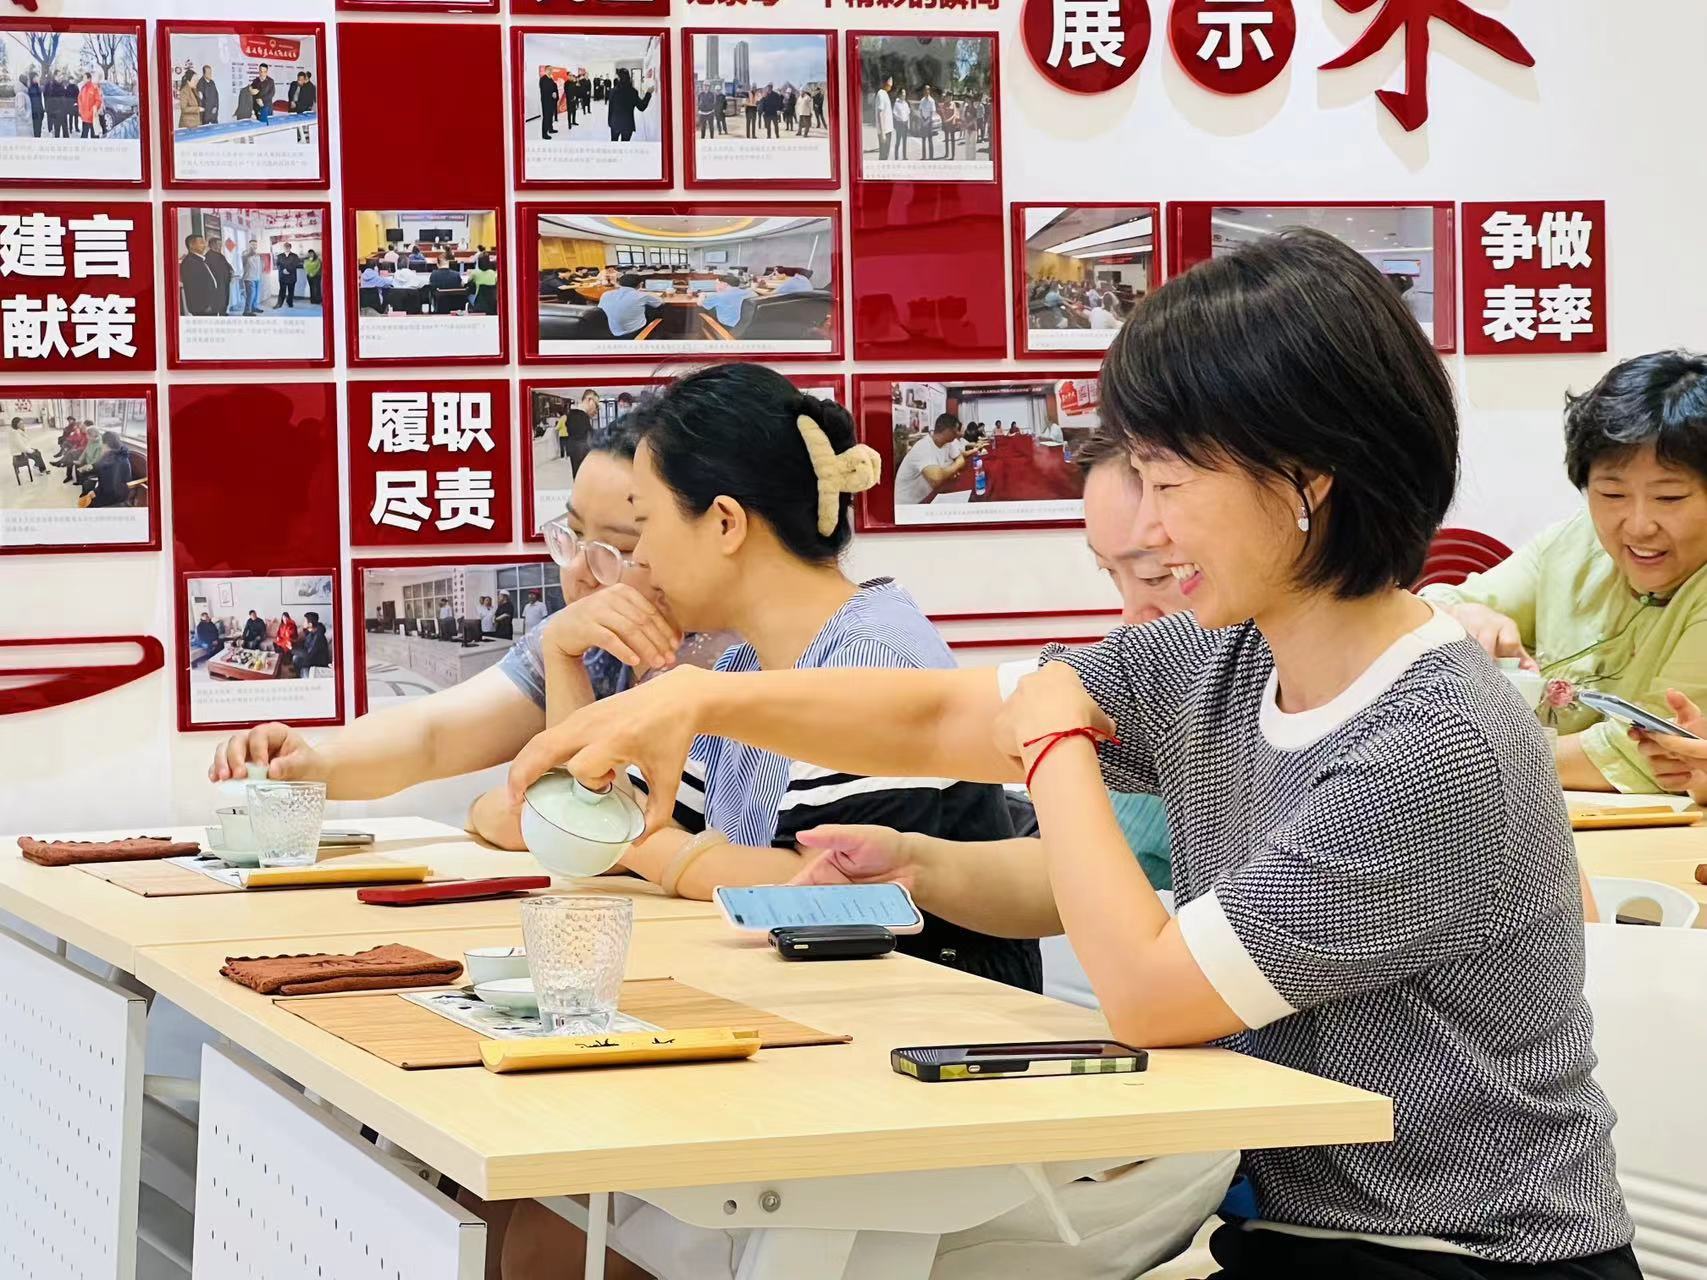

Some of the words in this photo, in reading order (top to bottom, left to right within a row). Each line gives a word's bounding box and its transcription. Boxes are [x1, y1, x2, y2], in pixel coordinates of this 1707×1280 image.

[0, 213, 134, 278] 建言
[1481, 211, 1592, 270] 争做
[1, 294, 137, 359] 献策
[1482, 284, 1593, 342] 表率
[368, 392, 495, 453] 履职
[370, 467, 495, 531] 尽责
